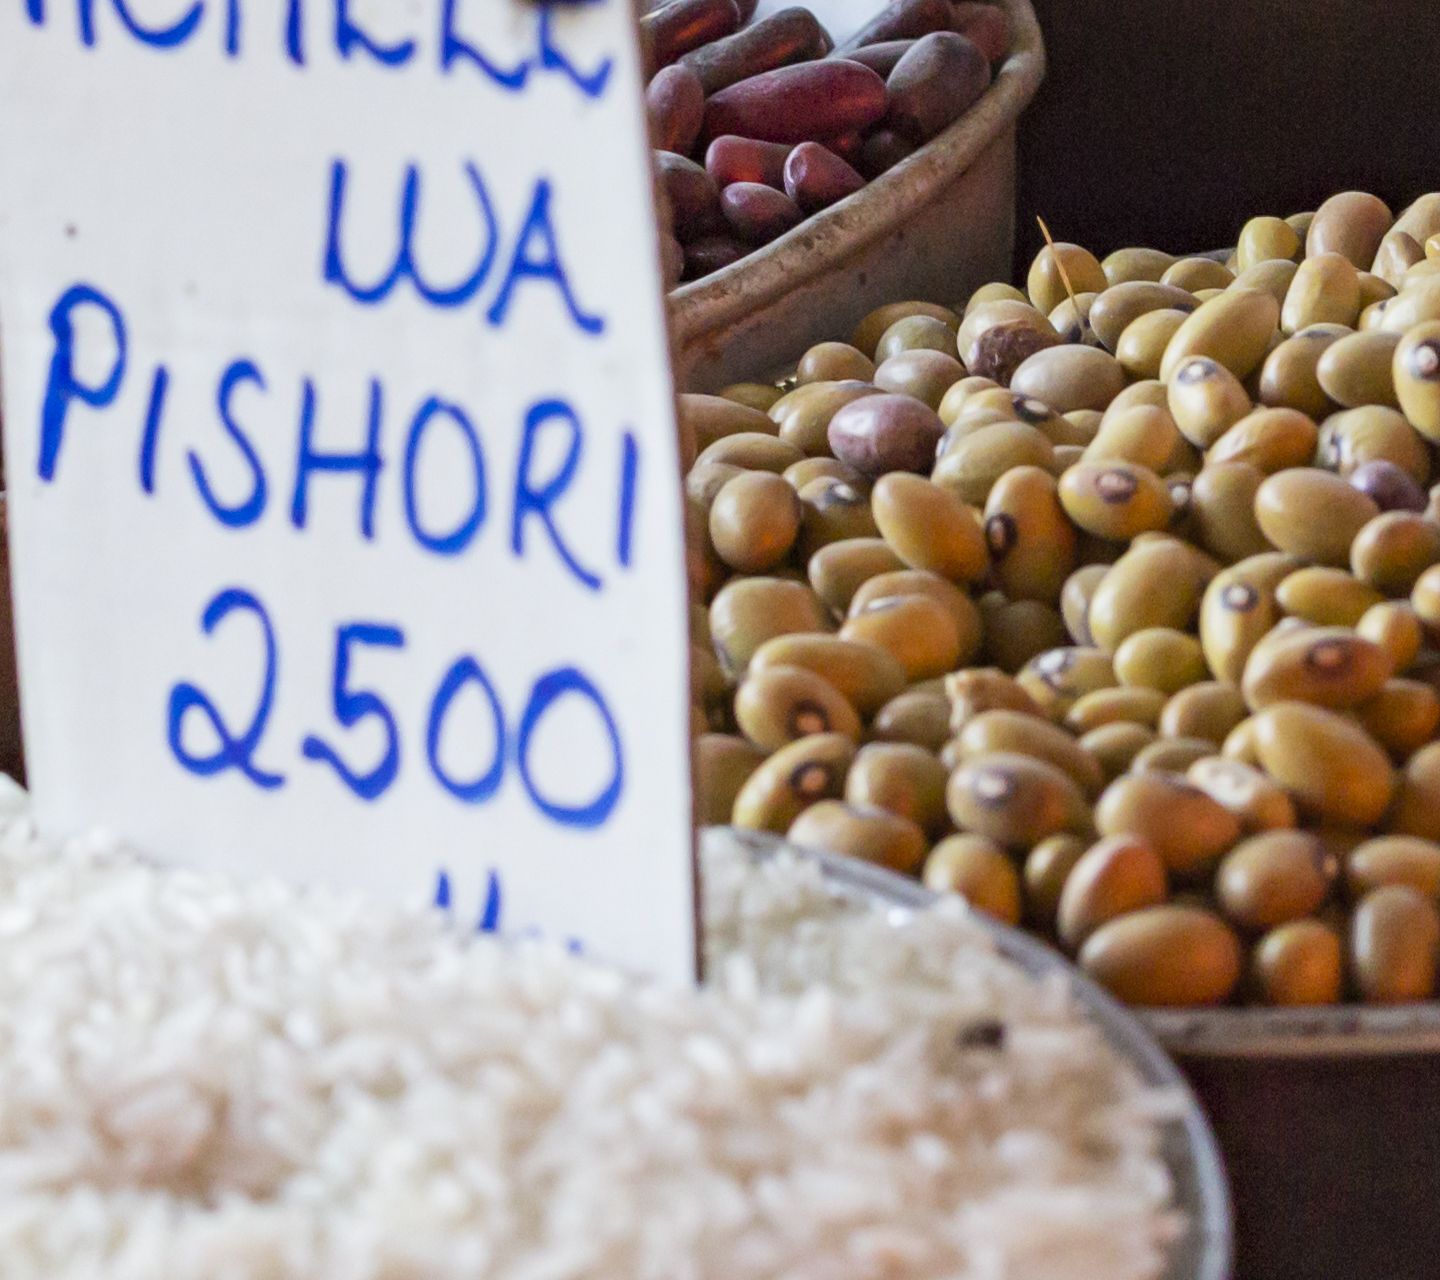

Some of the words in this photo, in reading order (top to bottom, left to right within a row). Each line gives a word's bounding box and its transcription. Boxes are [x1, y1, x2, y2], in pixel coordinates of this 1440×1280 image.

[324, 157, 604, 334] WA
[36, 281, 642, 591] PISHORI
[167, 586, 624, 828] 2500
